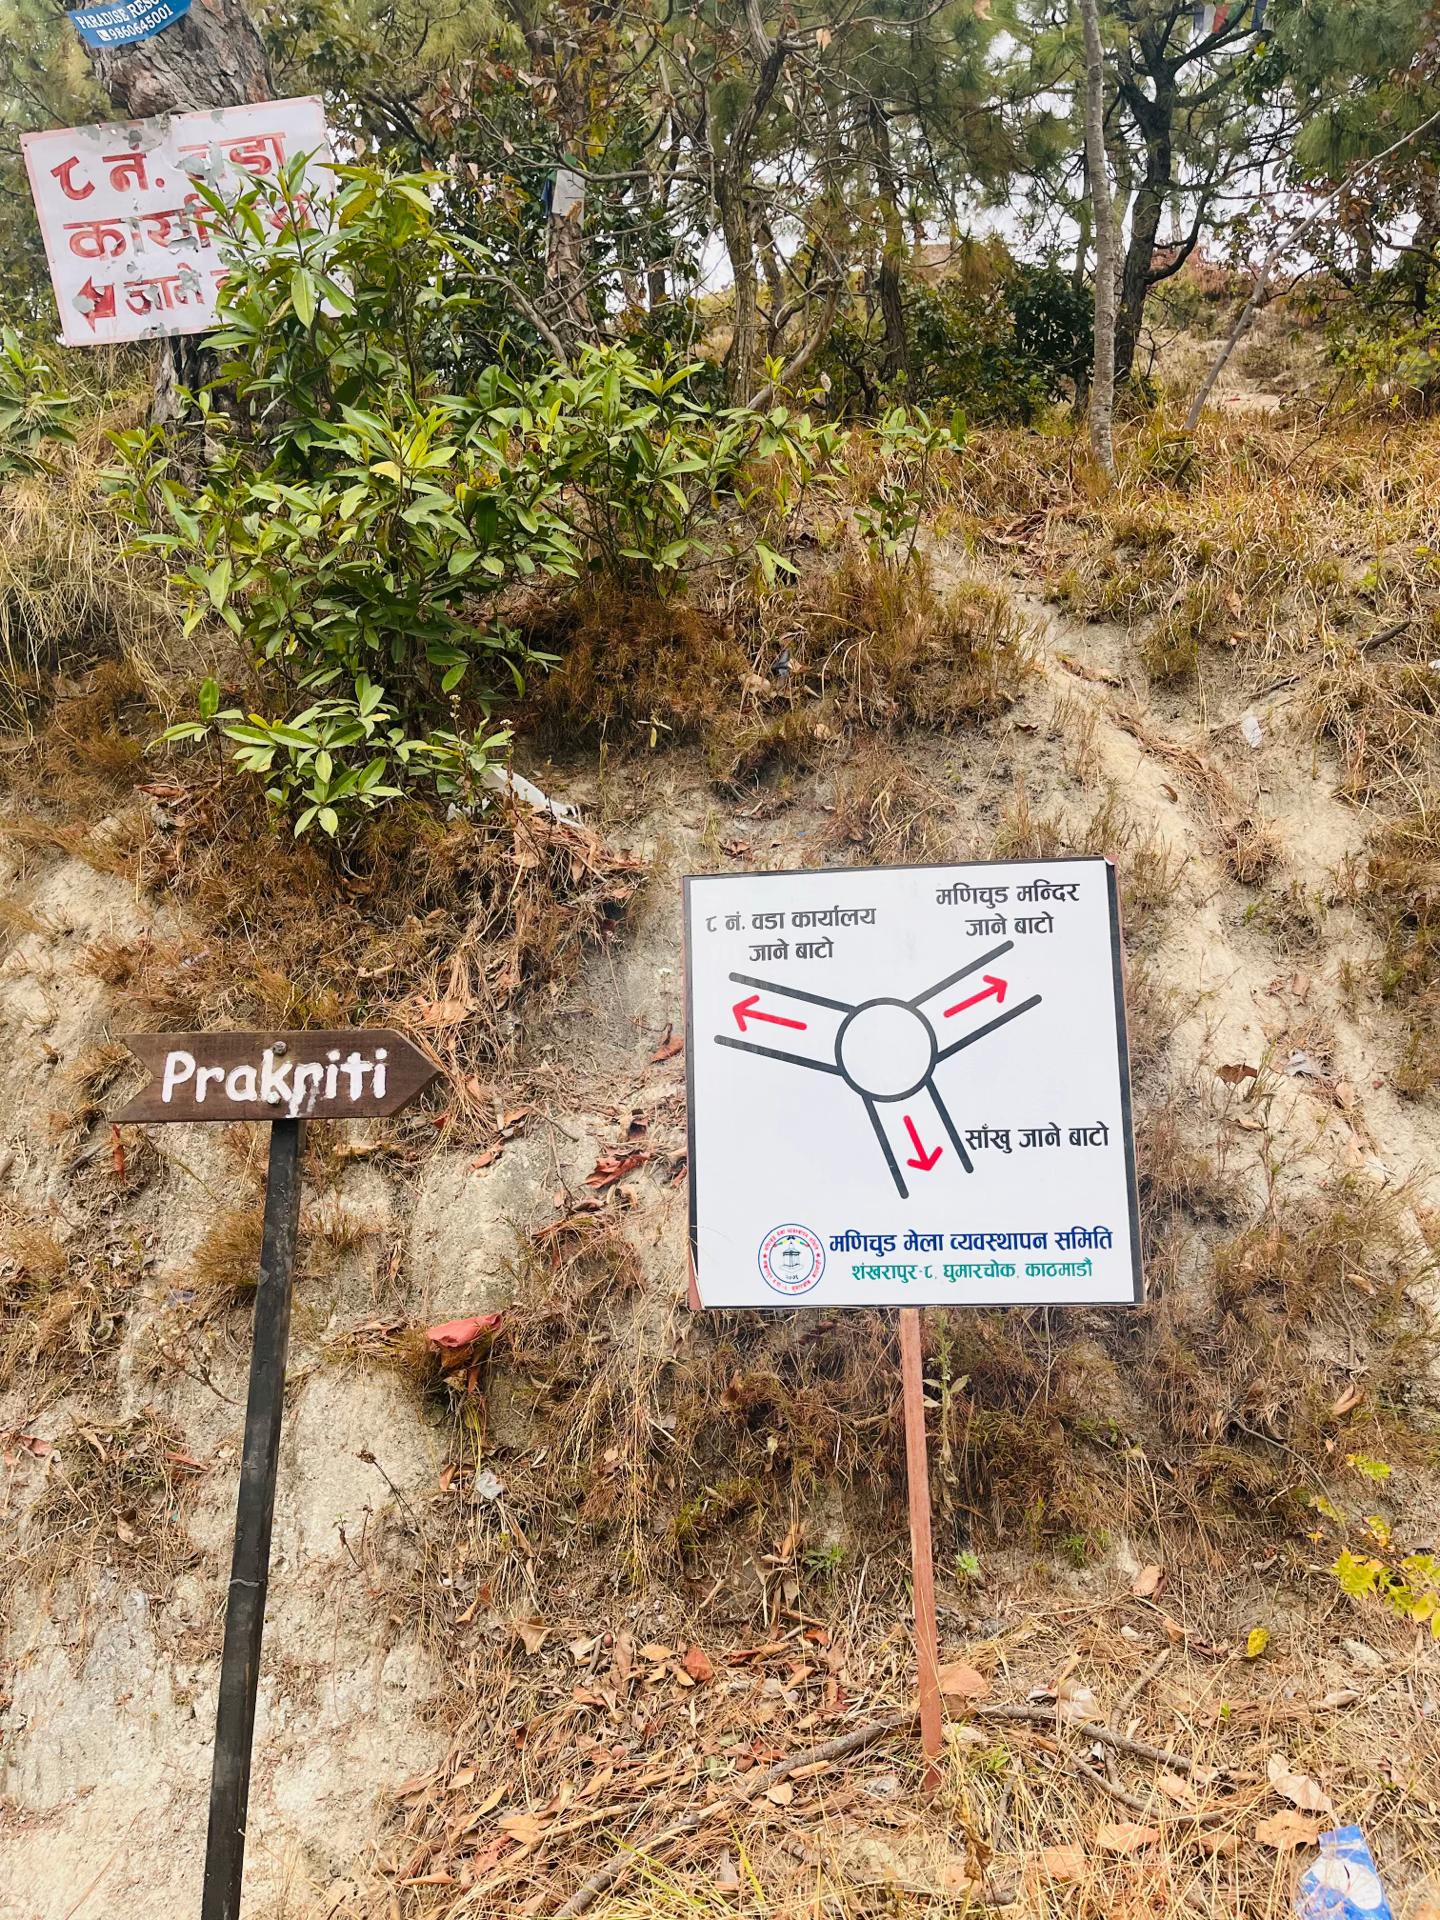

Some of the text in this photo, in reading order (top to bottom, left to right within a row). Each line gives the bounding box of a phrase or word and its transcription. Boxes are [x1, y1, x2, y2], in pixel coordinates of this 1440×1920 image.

[75, 8, 130, 29] PARADISE
[109, 3, 173, 40] 9860645001
[50, 156, 95, 200] ८
[178, 132, 287, 179] डा
[936, 878, 1080, 909] मणिचुड मन्दिर
[705, 905, 876, 932] ८ नं. वडा कार्यालय
[965, 911, 1054, 936] जाने बाटो
[749, 936, 834, 962] जाने बाटो
[965, 1121, 1109, 1154] साँखु जाने बाटो
[829, 1229, 897, 1257] मणिचुड
[903, 1228, 944, 1252] मेला
[950, 1231, 1048, 1252] व्यवस्थापन
[1055, 1225, 1113, 1251] समिति
